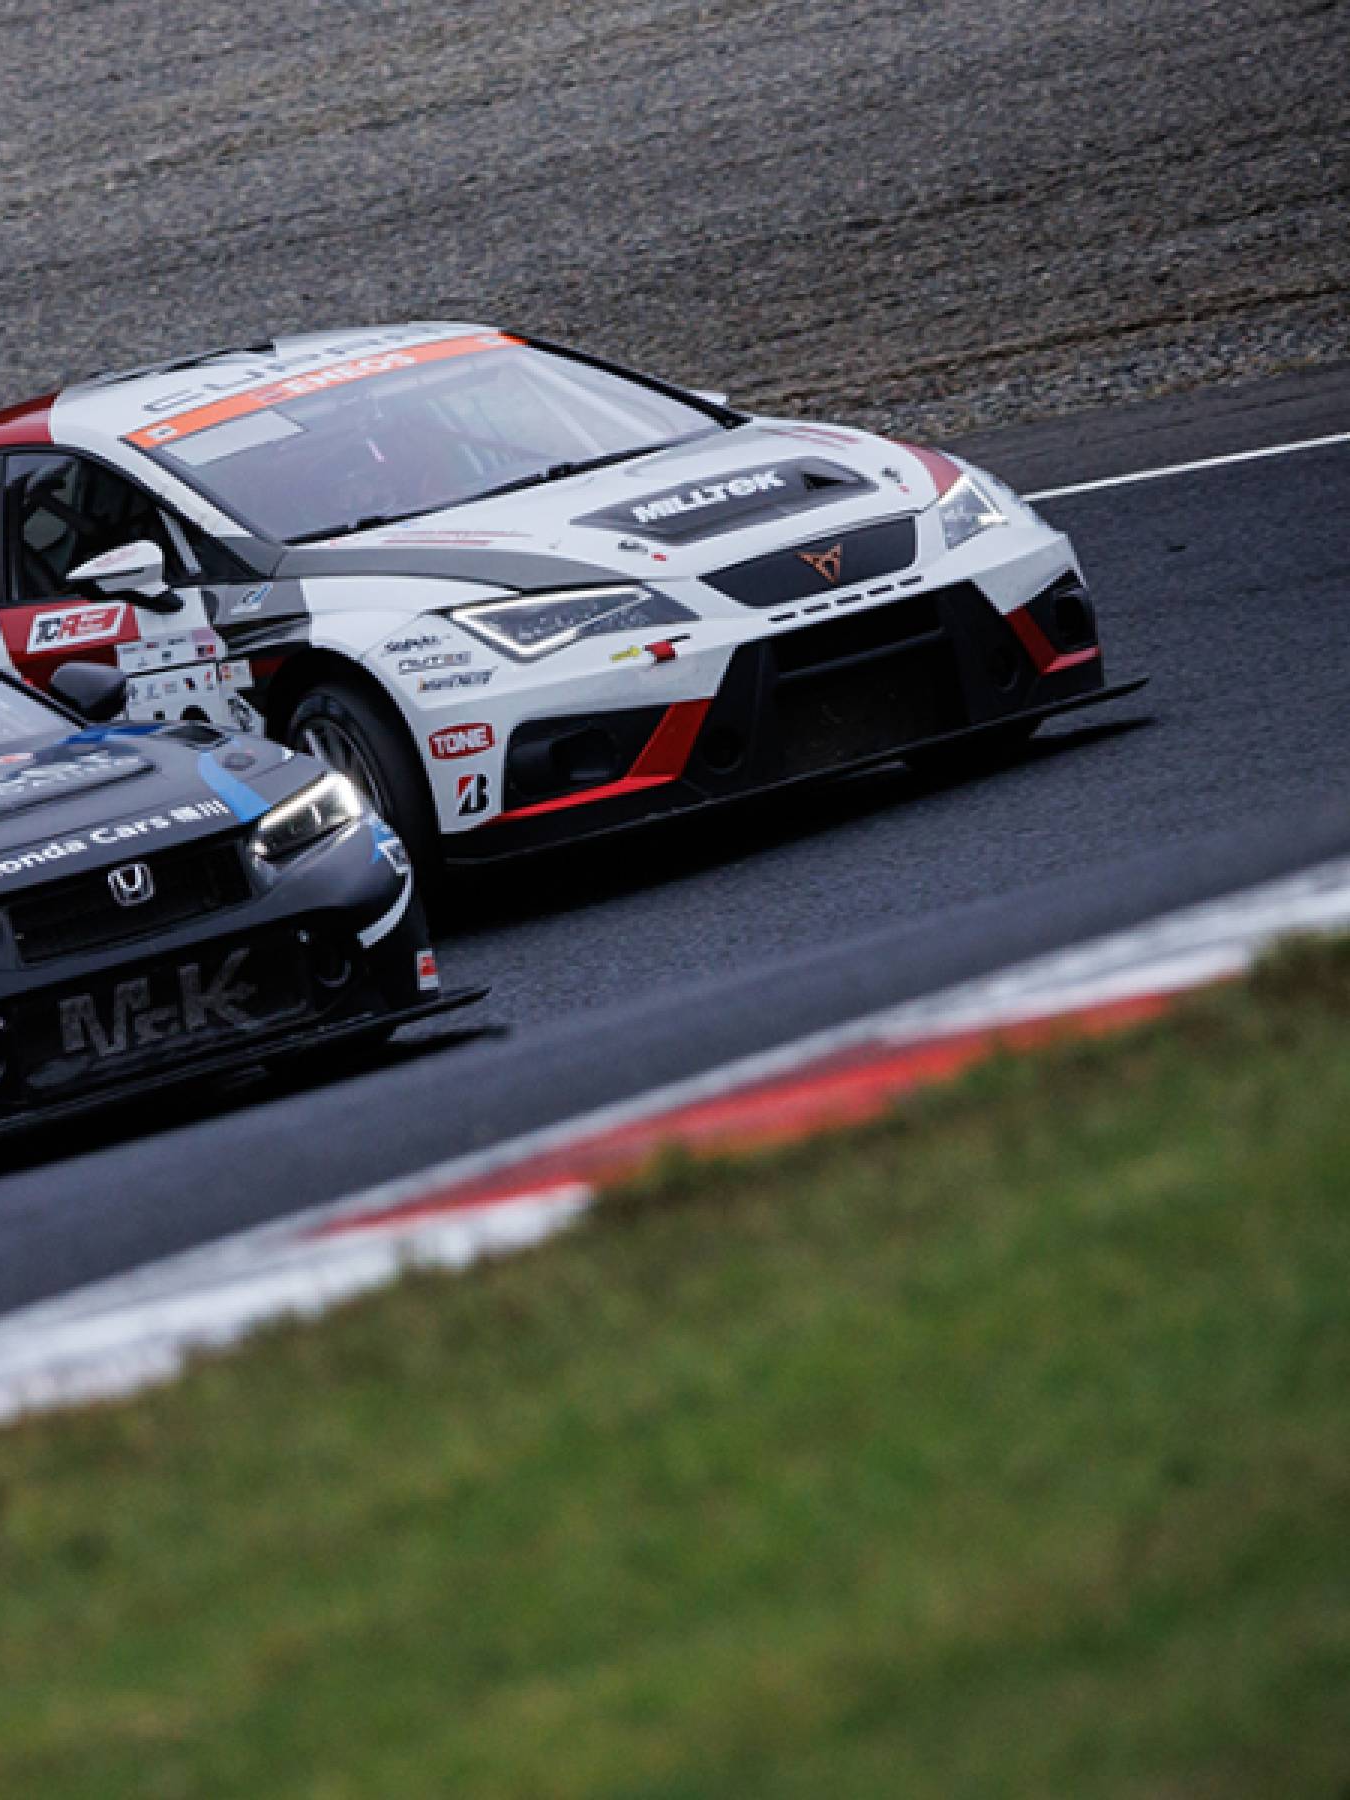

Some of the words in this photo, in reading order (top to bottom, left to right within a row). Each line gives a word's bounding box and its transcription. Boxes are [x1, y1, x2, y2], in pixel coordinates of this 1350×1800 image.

[283, 353, 416, 394] ENEOS
[631, 470, 786, 524] MILLTEK
[432, 728, 490, 755] TONE
[89, 814, 170, 845] Cars
